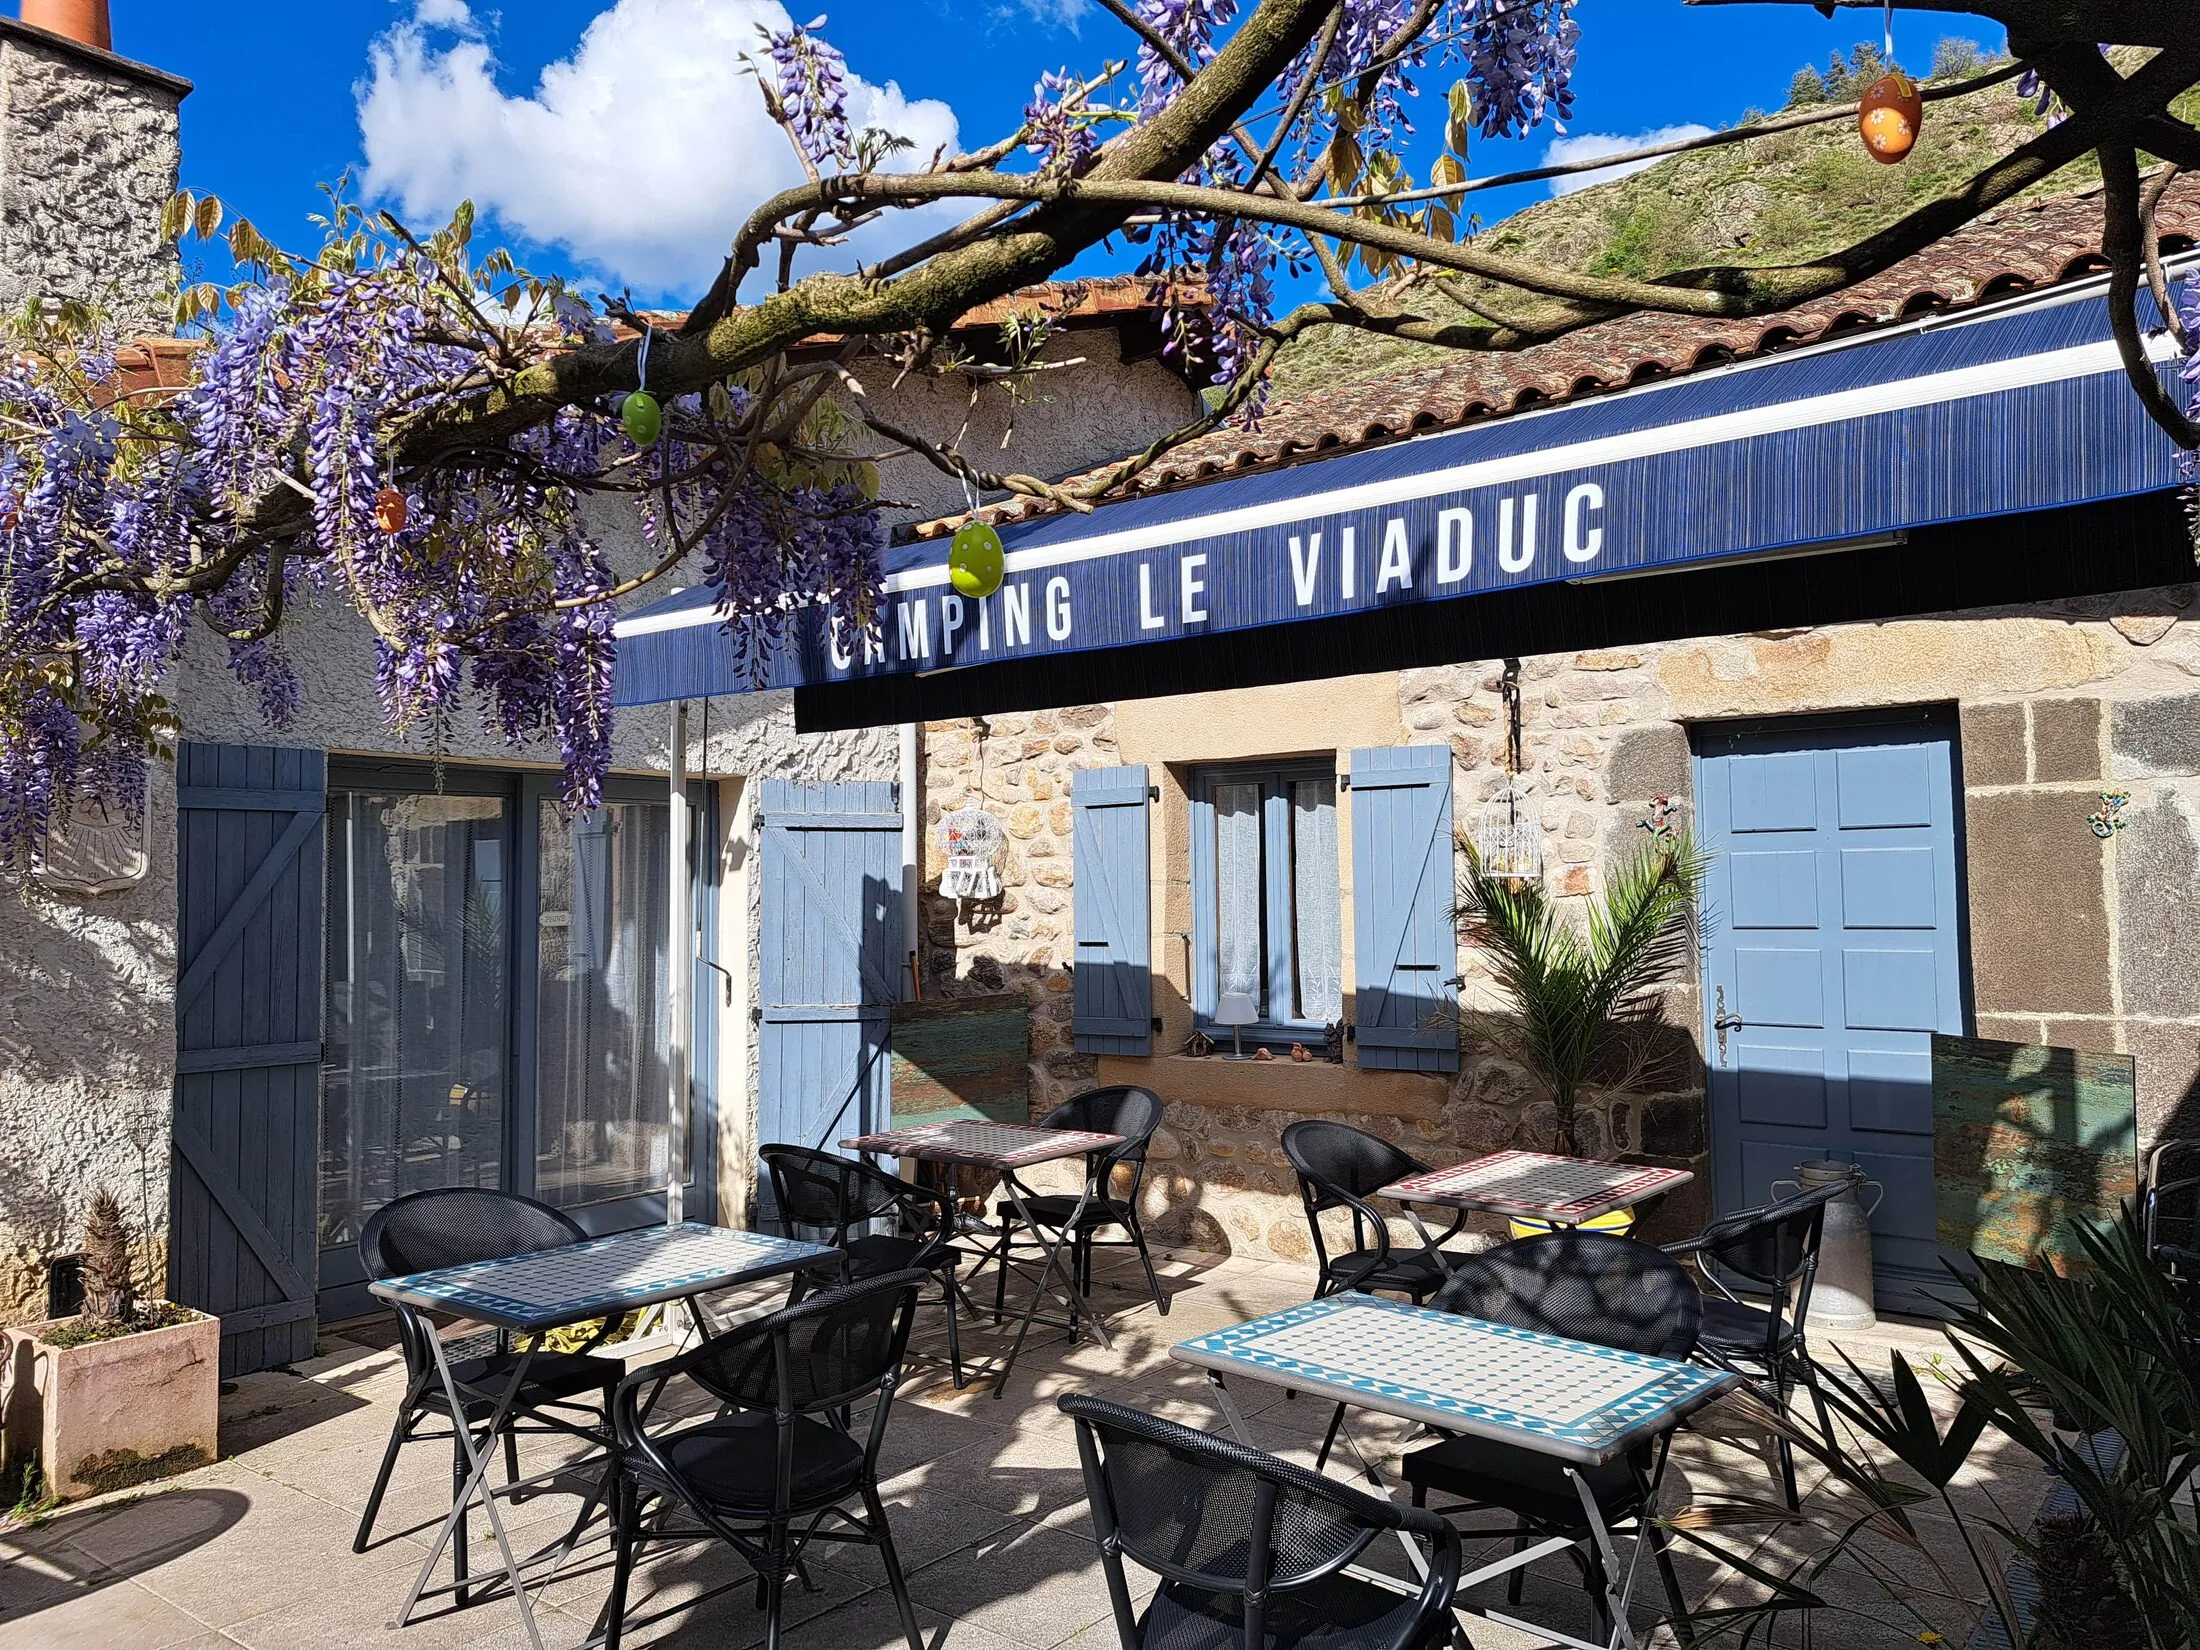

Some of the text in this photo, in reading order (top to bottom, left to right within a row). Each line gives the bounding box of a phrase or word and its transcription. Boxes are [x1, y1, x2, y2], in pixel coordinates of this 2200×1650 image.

[831, 483, 1604, 670] CAMPING LE VIADUC
